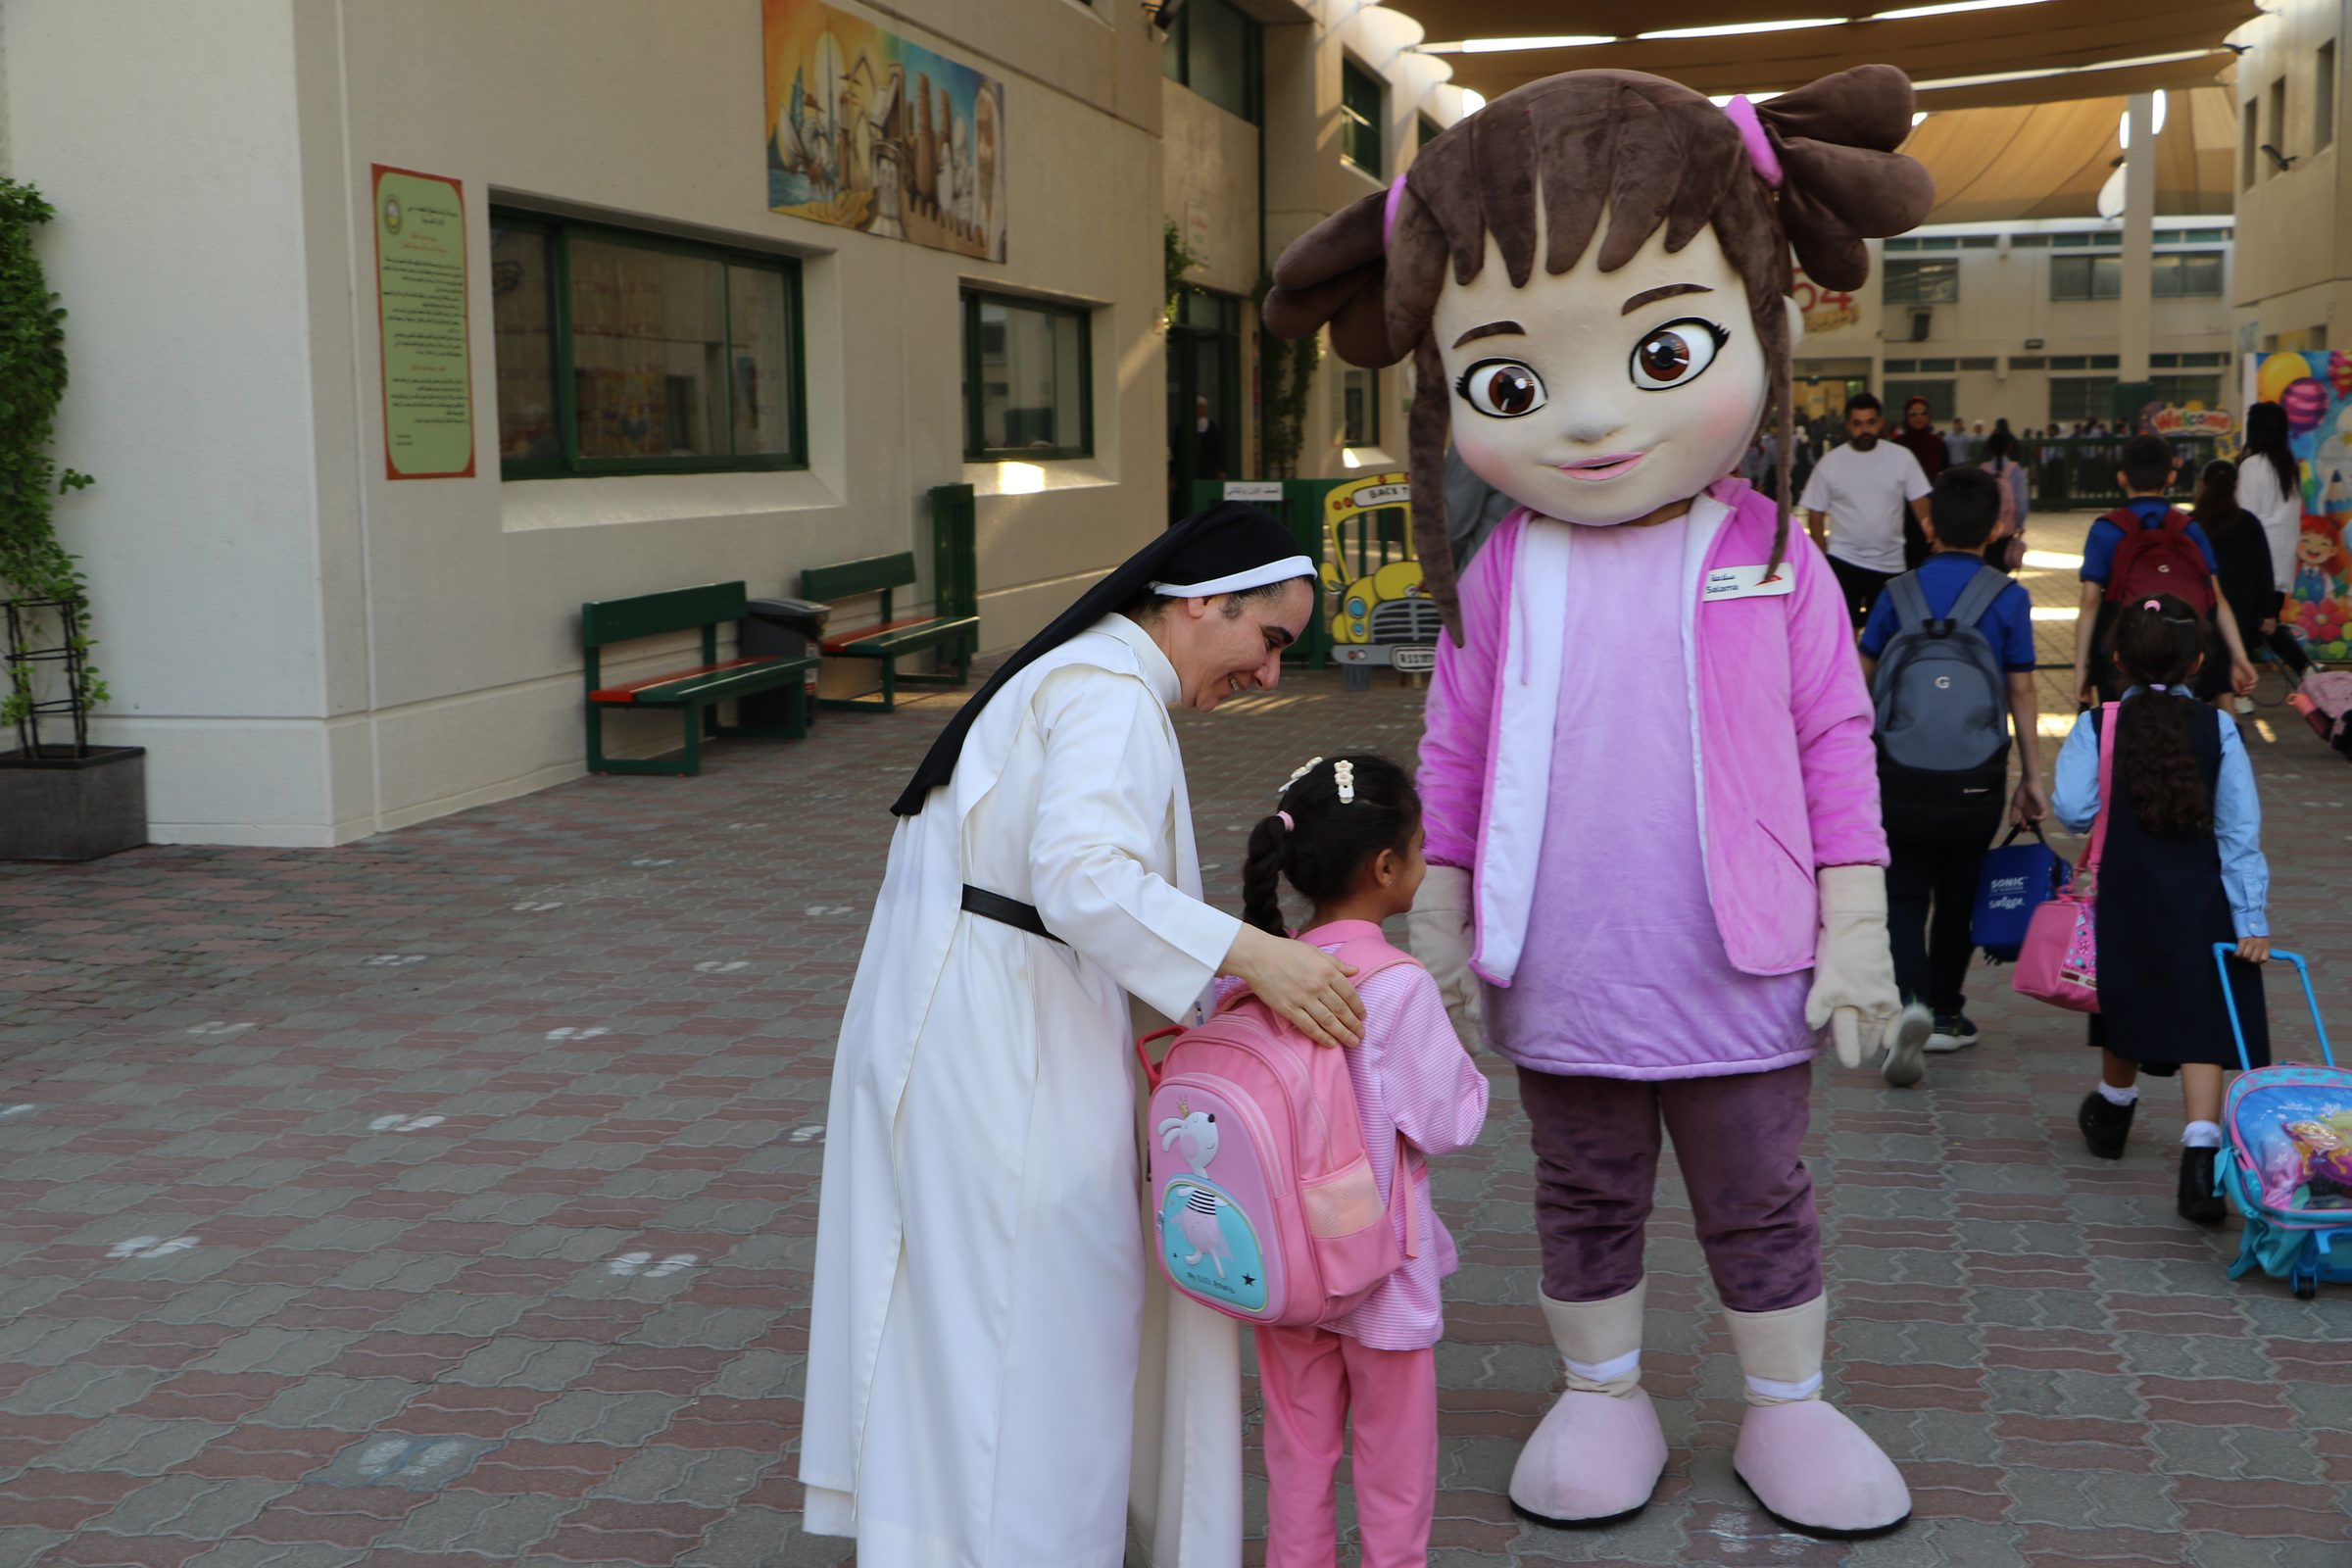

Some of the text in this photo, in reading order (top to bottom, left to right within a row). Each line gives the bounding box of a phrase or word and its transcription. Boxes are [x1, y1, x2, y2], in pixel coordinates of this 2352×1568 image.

[2154, 410, 2230, 430] Welcome
[1369, 487, 1397, 498] BACK
[1935, 676, 1950, 689] G
[1990, 876, 2024, 889] SONIC
